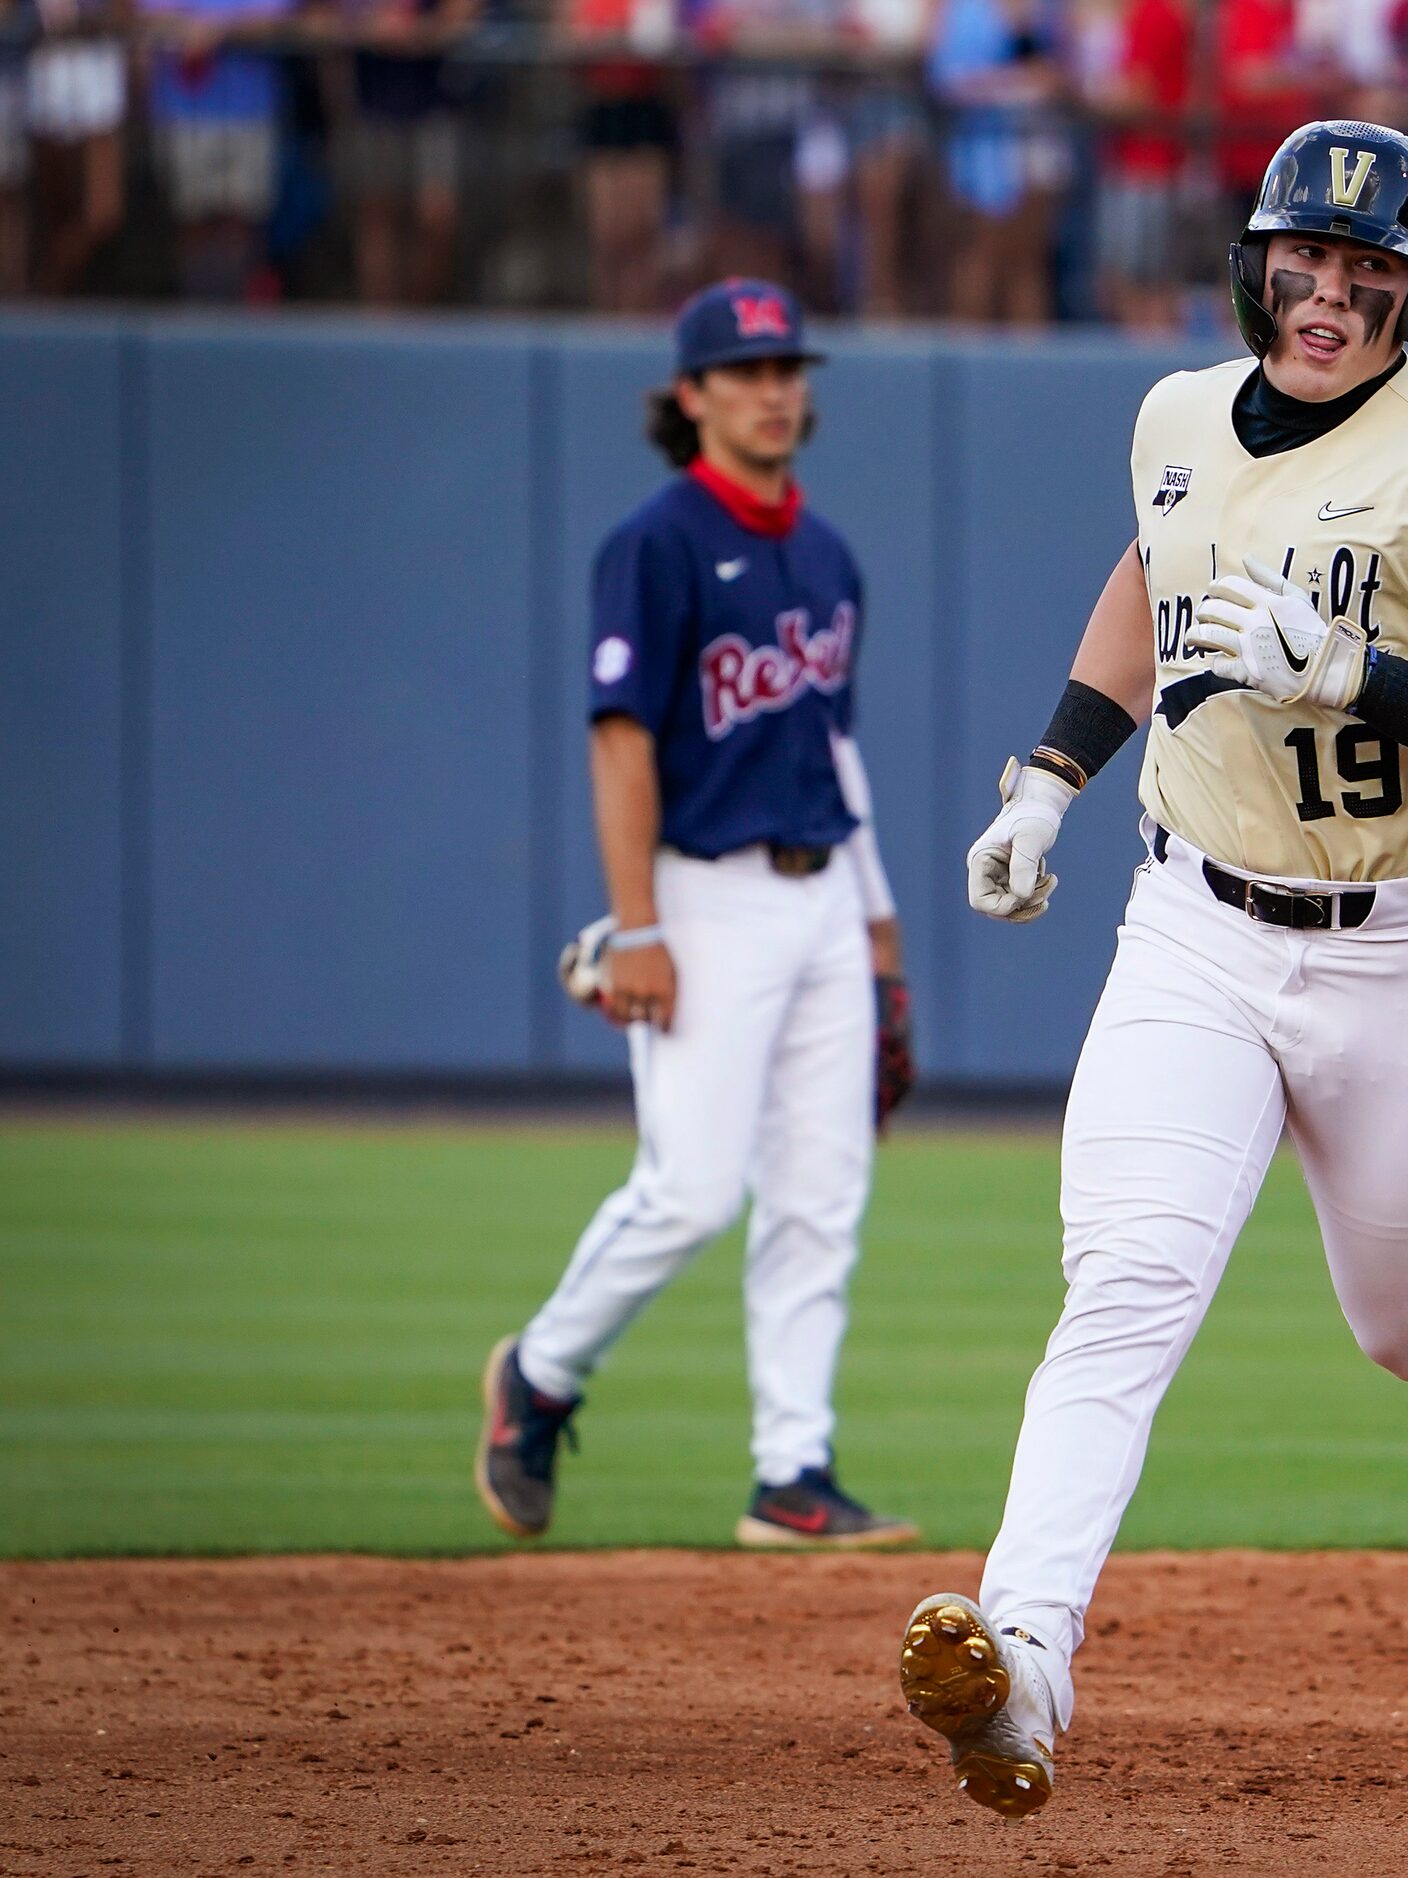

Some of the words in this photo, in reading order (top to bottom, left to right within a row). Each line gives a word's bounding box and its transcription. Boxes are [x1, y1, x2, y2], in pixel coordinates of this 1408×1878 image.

[1328, 146, 1377, 207] V
[1162, 470, 1190, 488] NASH
[1337, 625, 1362, 641] TROUT
[1283, 722, 1402, 822] 19
